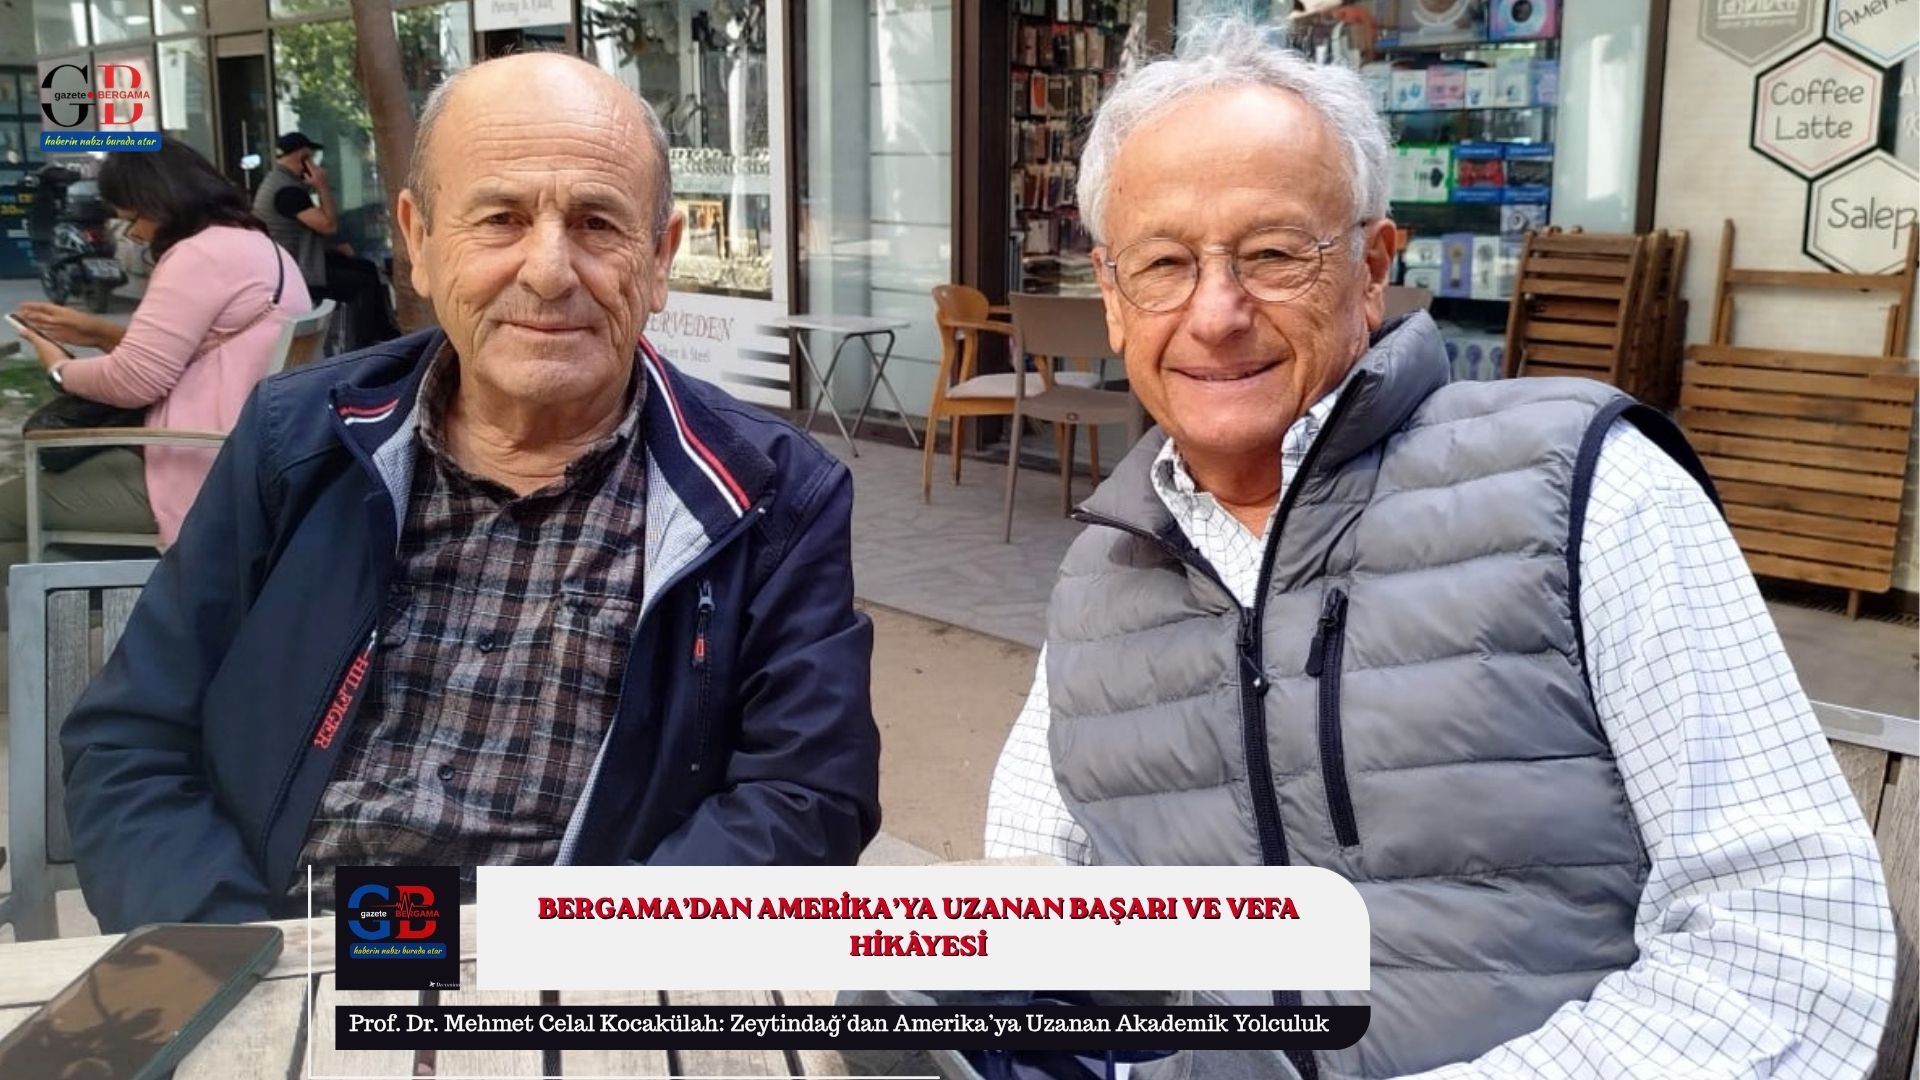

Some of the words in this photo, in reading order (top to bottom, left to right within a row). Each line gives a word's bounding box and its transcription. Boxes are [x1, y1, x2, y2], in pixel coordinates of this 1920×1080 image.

[1770, 78, 1865, 105] Coffee
[1775, 115, 1853, 140] Latte
[1827, 196, 1918, 249] Salep
[644, 308, 735, 344] ERVEDEN
[313, 654, 369, 750] HILFIGER
